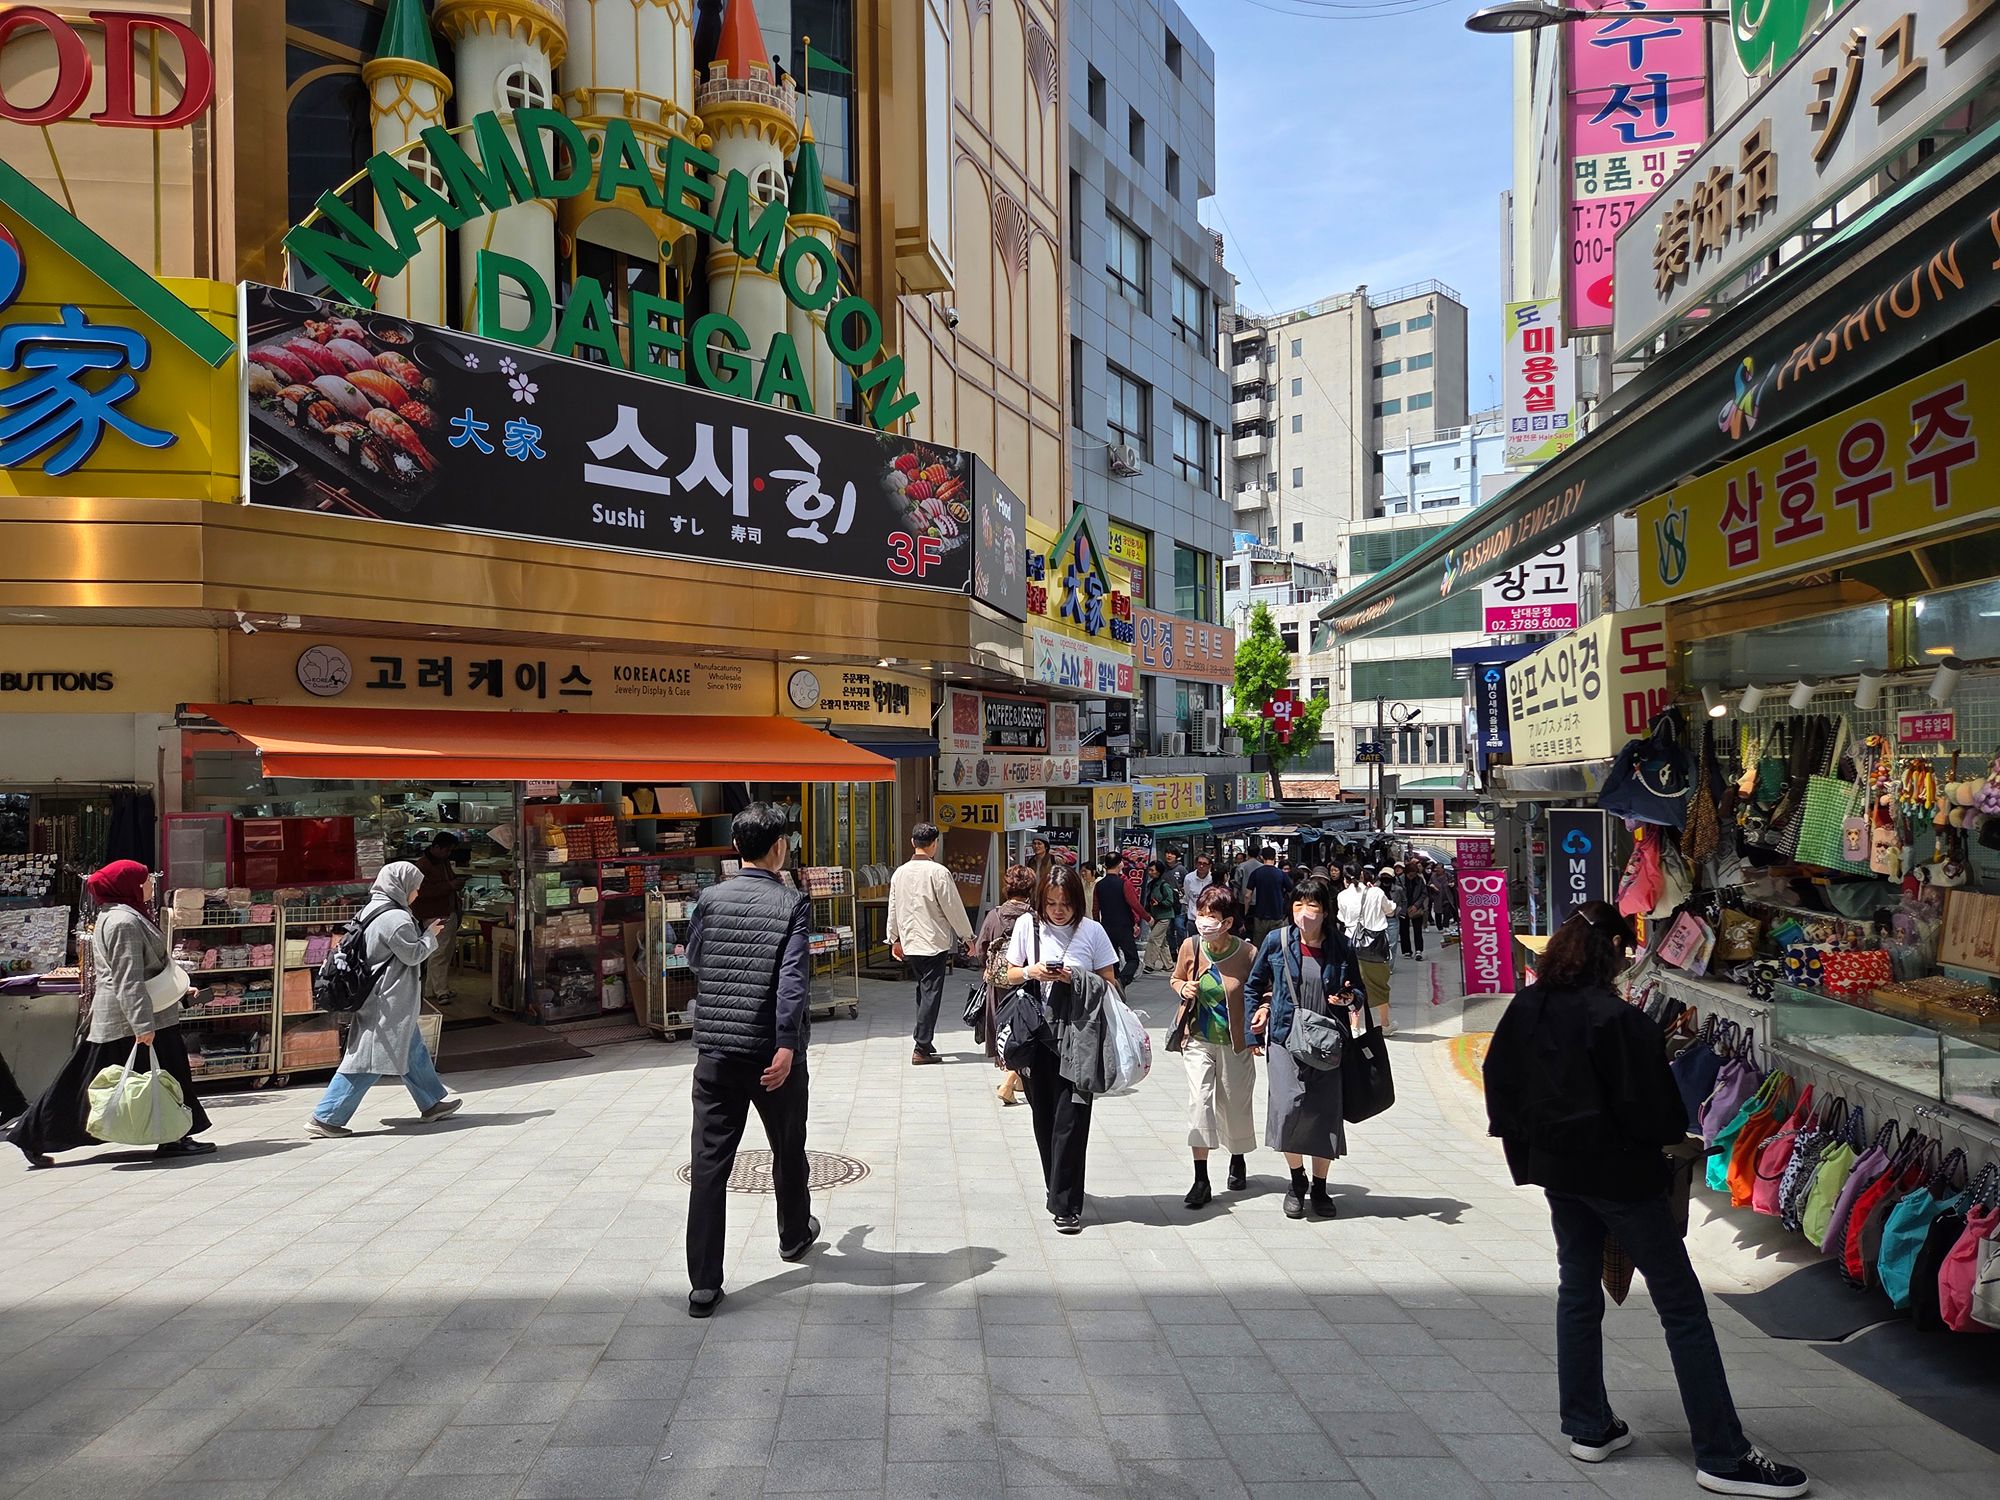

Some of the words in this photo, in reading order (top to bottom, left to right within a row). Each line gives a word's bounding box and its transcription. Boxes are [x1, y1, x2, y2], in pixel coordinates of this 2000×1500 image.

[1651, 118, 1777, 293] 装飾品
[283, 107, 920, 430] NAMDAEMOON
[1778, 236, 1964, 391] FASHION
[477, 249, 814, 414] DAEGA
[1521, 326, 1558, 413] 미용실
[1513, 414, 1568, 432] 美容室
[448, 407, 547, 461] 大家
[1538, 433, 1553, 441] Hair
[1554, 432, 1573, 441] Salon
[1718, 383, 1976, 568] 삼호우주
[592, 503, 645, 529] Sushi
[670, 515, 705, 535] すし
[731, 524, 762, 544] 寿司
[1460, 524, 1513, 577] FASHION
[1513, 480, 1586, 547] JEWELRY
[886, 531, 942, 578] 3F
[1511, 607, 1552, 618] 남대문점
[1491, 617, 1571, 631] 02.3789.6002
[0, 672, 113, 692] BUTTONS
[366, 656, 593, 699] 고려케이스
[707, 682, 725, 690] Since
[726, 683, 742, 691] 1989
[708, 673, 742, 682] Wholesale
[1510, 632, 1601, 721] 알프스안경
[614, 685, 641, 697] Jewelry
[642, 685, 667, 698] Display
[668, 687, 673, 696] &
[674, 686, 691, 696] Case
[1272, 701, 1292, 722] 약
[1528, 711, 1581, 739] アルプスメガネ
[1359, 753, 1381, 761] GATE
[1366, 744, 1374, 754] 3
[1106, 793, 1127, 813] Coffee
[1156, 782, 1193, 811] 금강석
[961, 804, 998, 824] 커피
[1018, 800, 1045, 822] 정육식당
[952, 871, 982, 885] OFFEE
[1466, 894, 1499, 907] 2020
